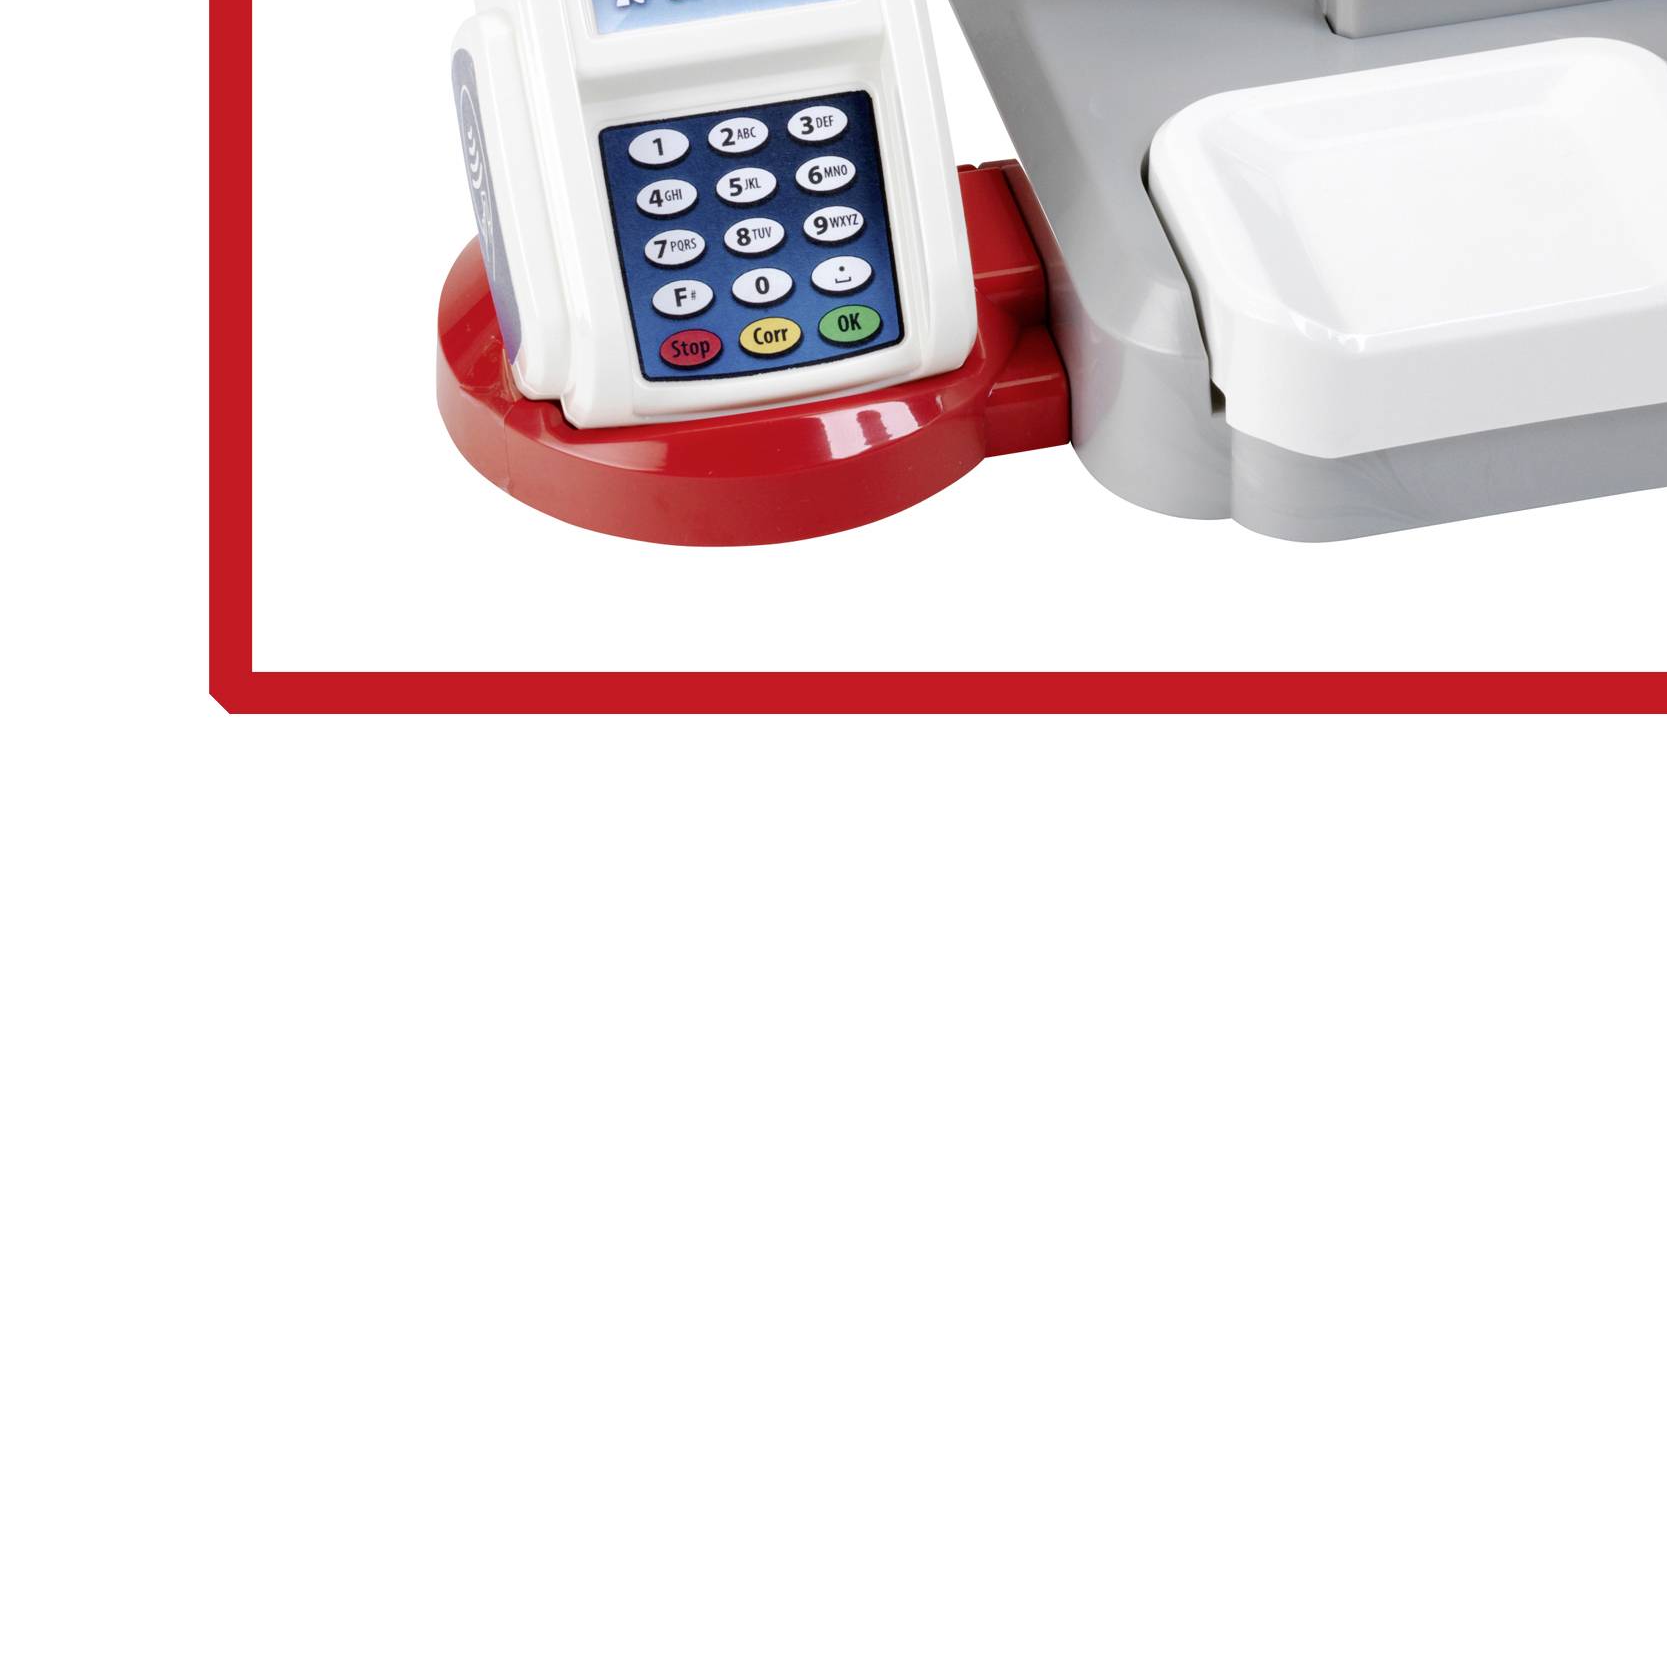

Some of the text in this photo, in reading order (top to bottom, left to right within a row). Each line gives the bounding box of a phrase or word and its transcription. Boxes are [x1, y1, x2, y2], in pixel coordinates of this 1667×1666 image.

[652, 137, 664, 157] 1
[671, 312, 862, 359] Stop Corr OK
